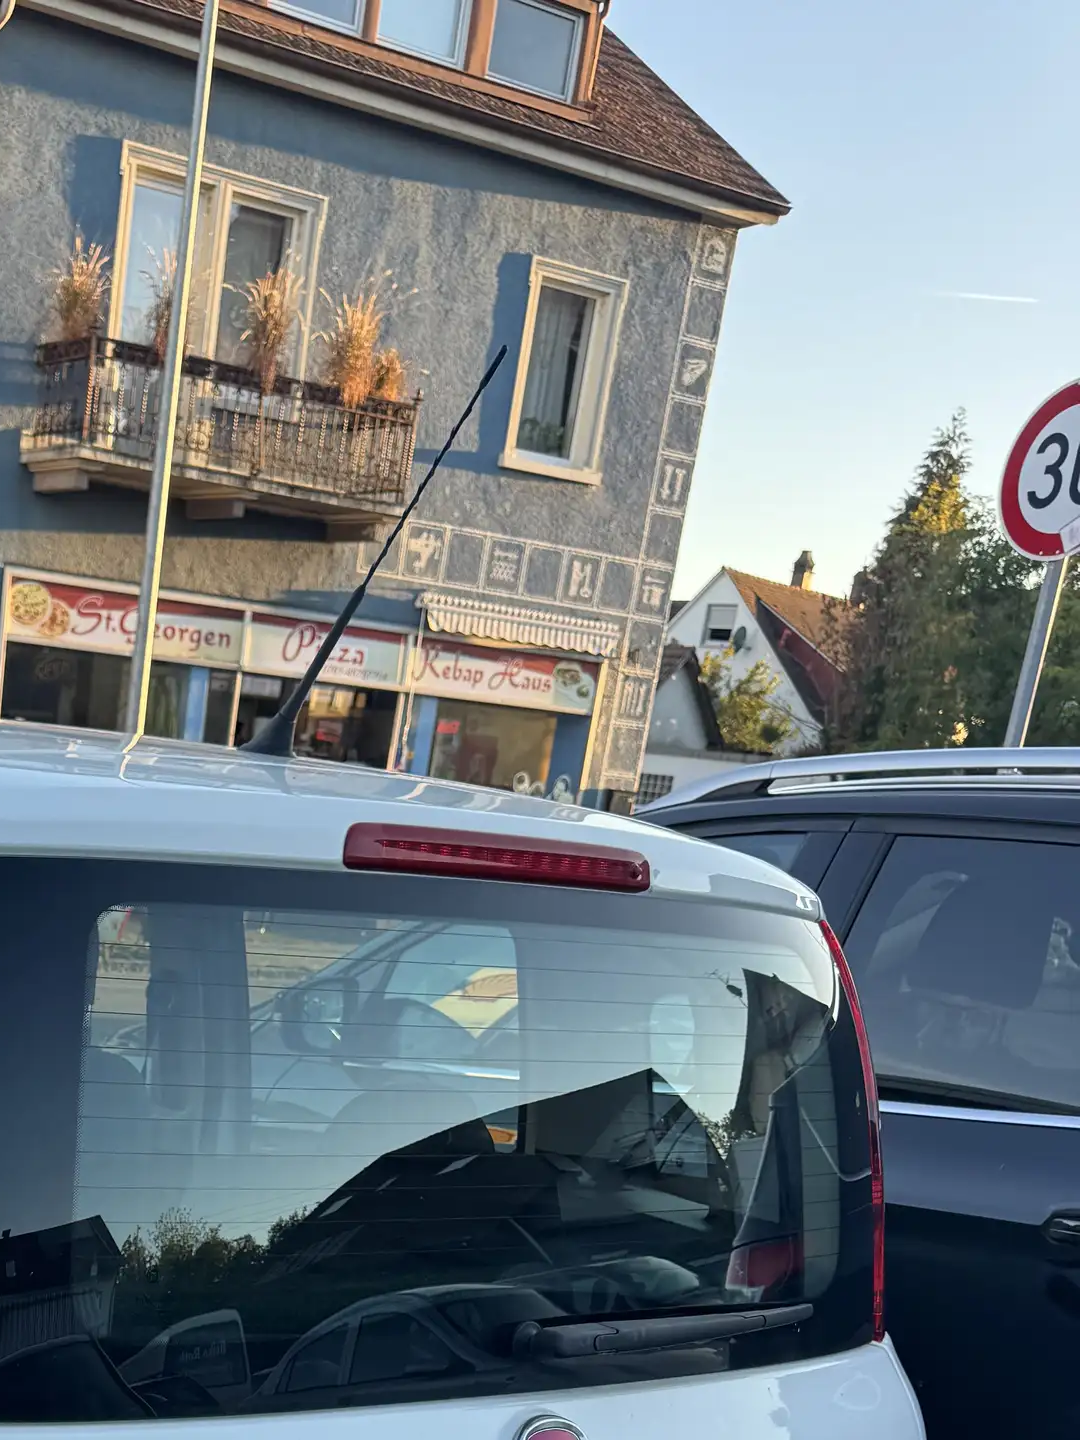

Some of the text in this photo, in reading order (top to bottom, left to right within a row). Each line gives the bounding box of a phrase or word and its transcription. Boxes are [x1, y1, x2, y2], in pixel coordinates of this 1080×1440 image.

[1027, 432, 1080, 510] 3
[414, 643, 484, 689] Kebap
[488, 655, 552, 693] Haus
